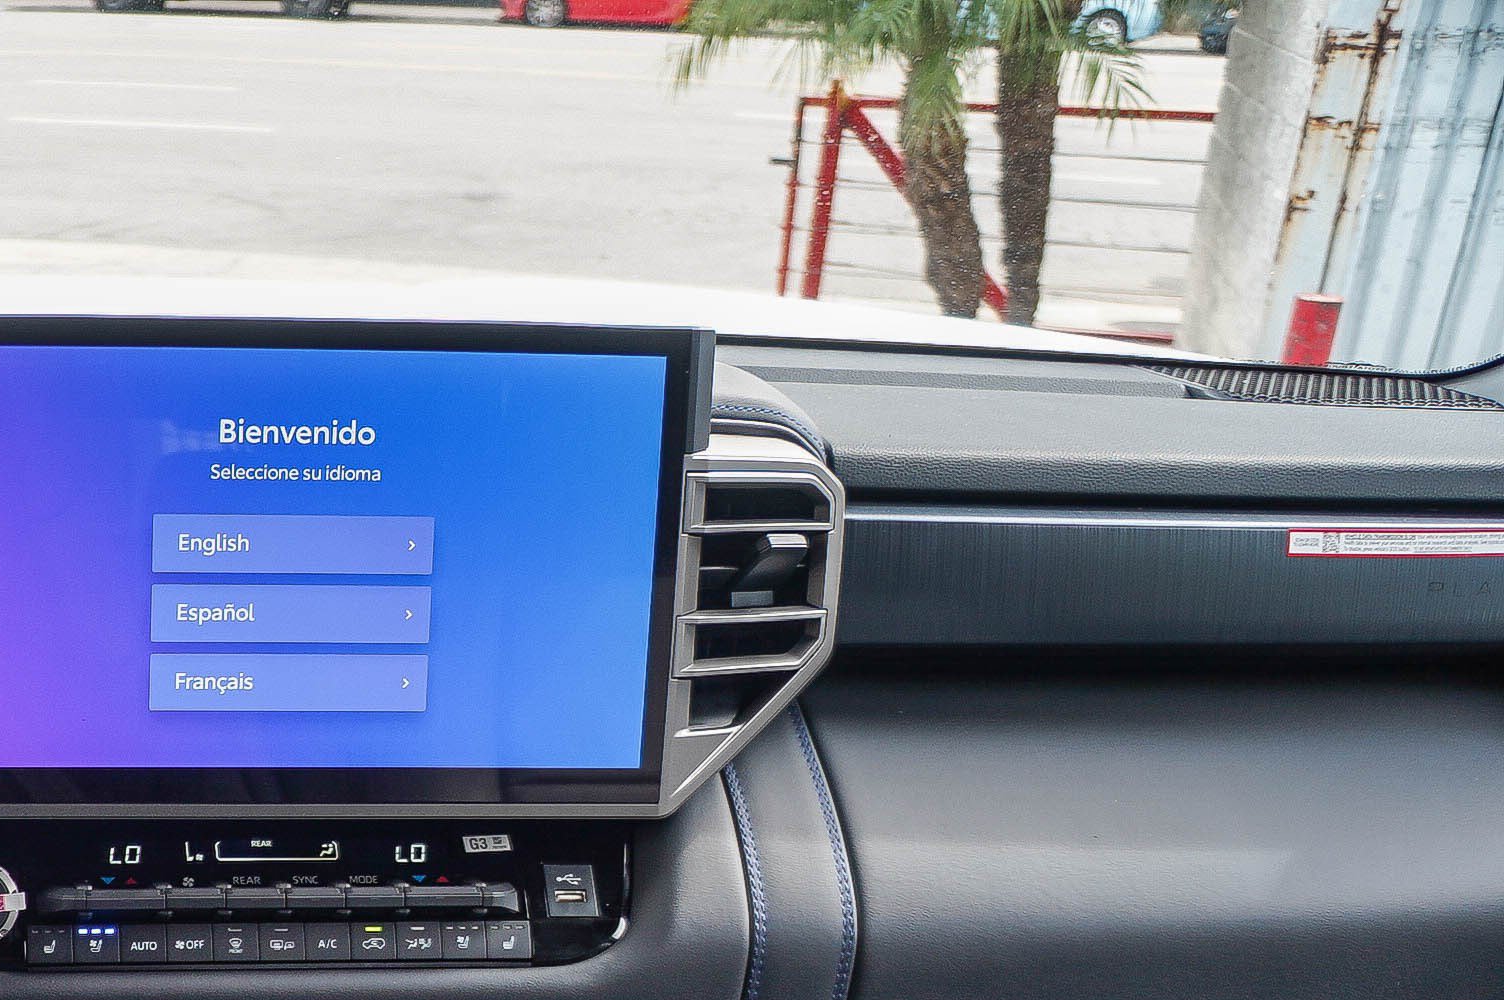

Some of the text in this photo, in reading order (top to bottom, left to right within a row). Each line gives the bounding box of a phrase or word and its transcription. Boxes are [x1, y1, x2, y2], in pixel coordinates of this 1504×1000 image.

[218, 418, 376, 446] Bienvenido
[209, 463, 382, 482] Seleccione su idioma
[177, 533, 251, 556] English
[176, 602, 255, 625] Español
[174, 672, 254, 695] Français
[251, 840, 273, 848] REAR
[469, 837, 488, 850] G3
[109, 845, 141, 864] LO
[396, 843, 426, 863] LO
[232, 876, 261, 885] REAR
[292, 875, 318, 885] SYNC
[349, 875, 378, 885] MODE
[130, 941, 158, 951] AUTO
[185, 940, 205, 949] OFF
[318, 938, 337, 949] A/C
